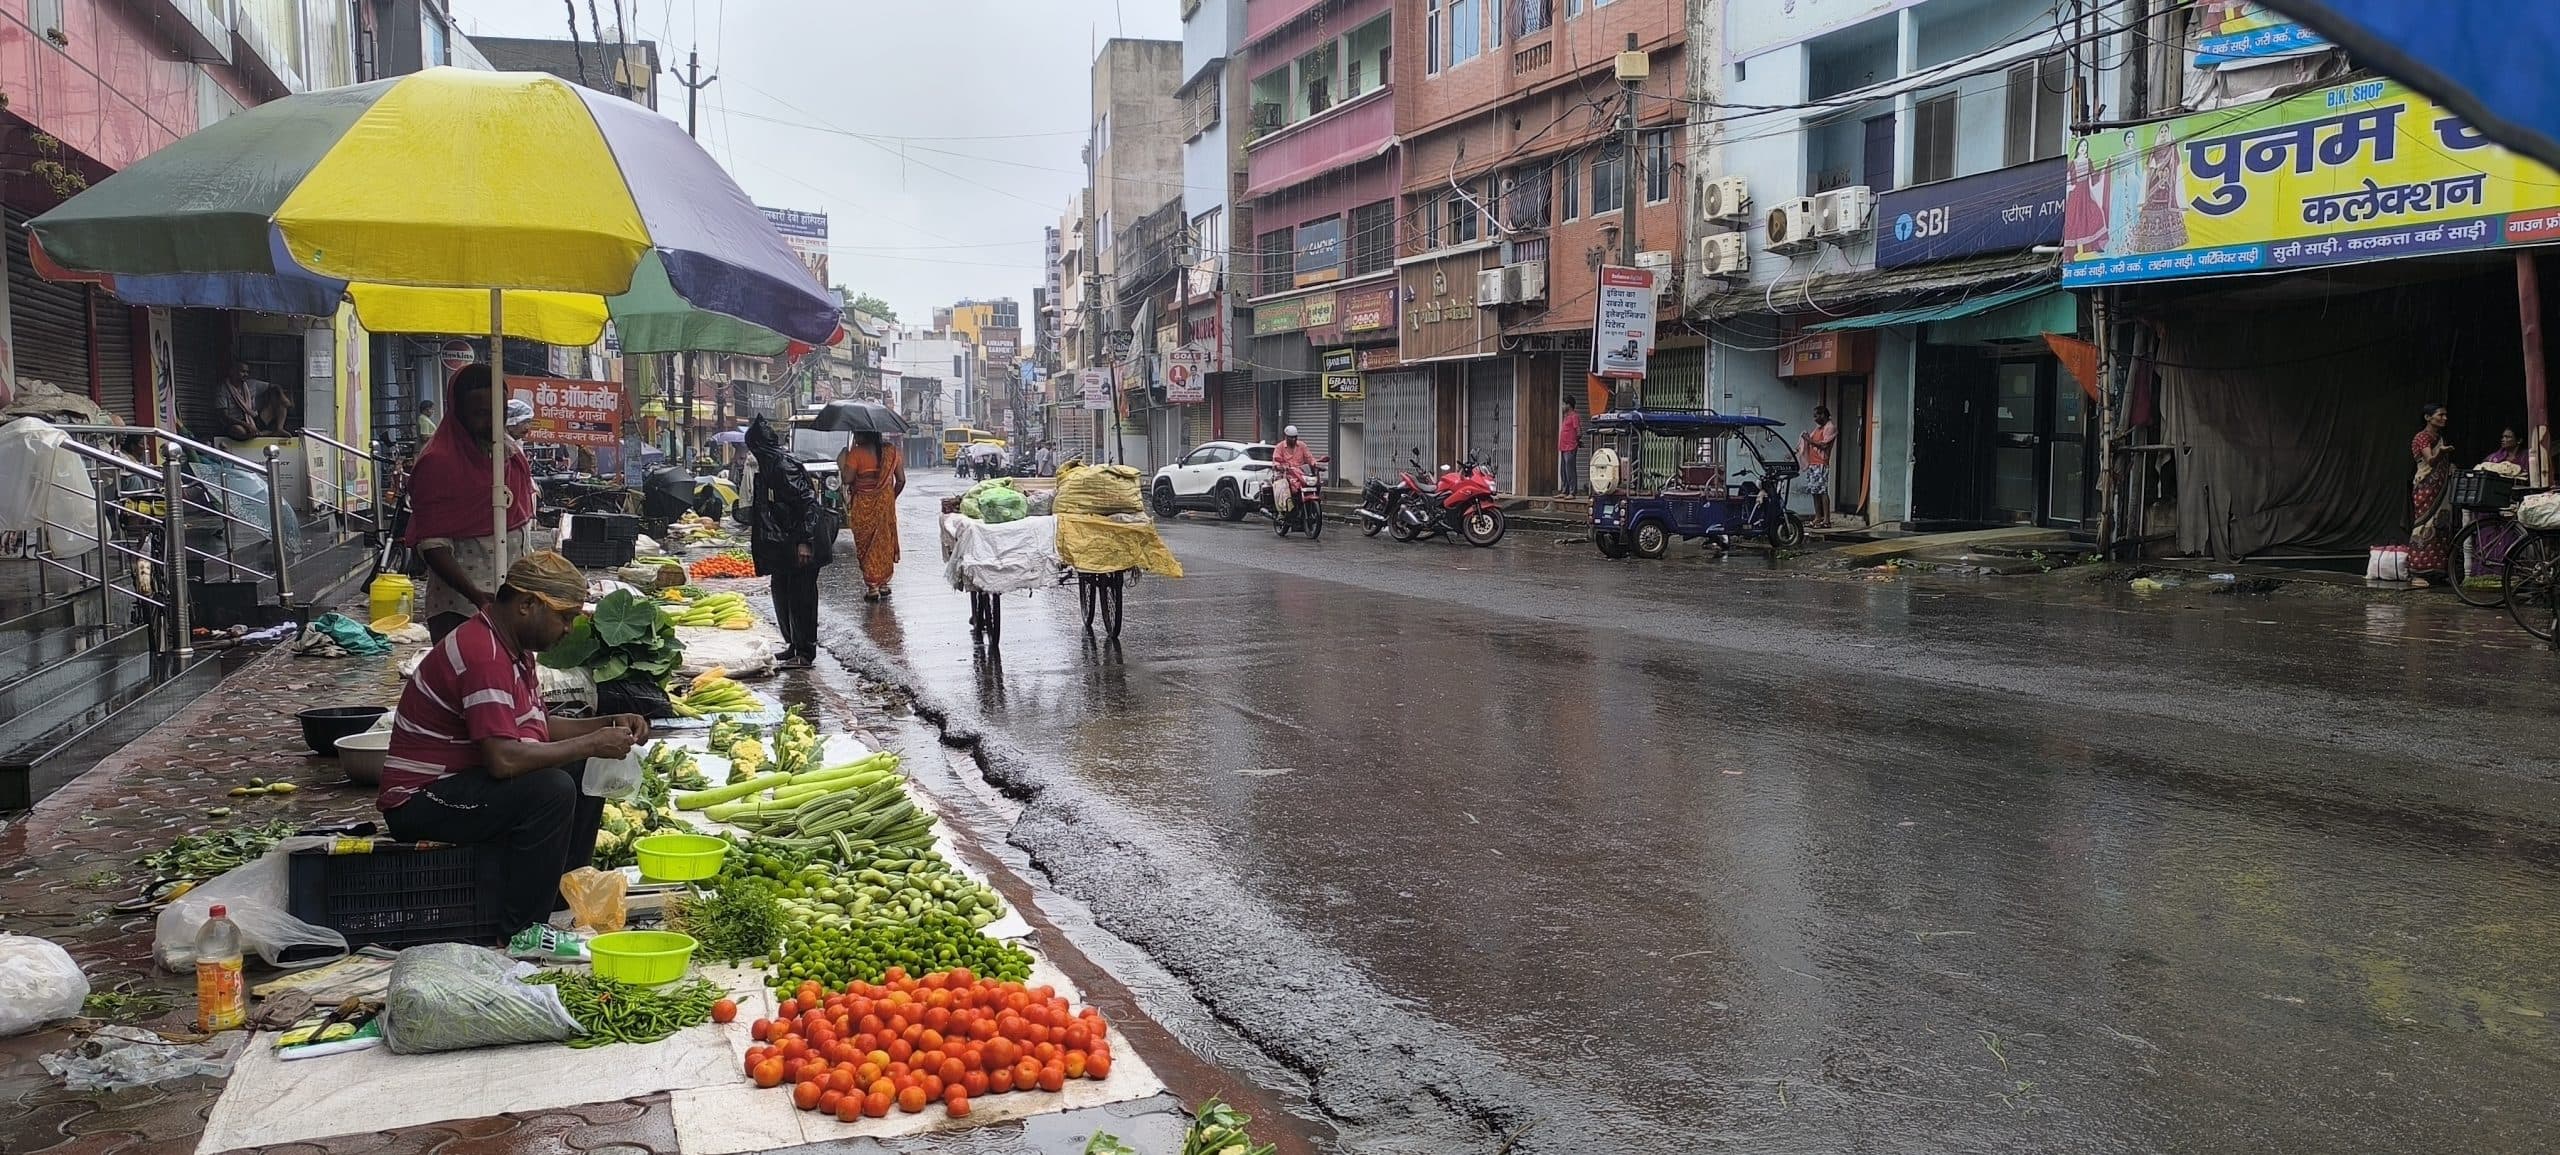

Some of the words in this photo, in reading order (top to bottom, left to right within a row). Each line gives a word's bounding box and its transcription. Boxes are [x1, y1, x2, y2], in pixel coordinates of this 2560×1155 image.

[2353, 82, 2385, 101] SHOP
[2185, 103, 2406, 217] पुनम
[2302, 172, 2488, 225] कलेक्शन
[1914, 206, 1950, 239] SBI
[2001, 202, 2033, 225] एटीएम
[2038, 199, 2065, 217] ATM
[2509, 219, 2543, 234] गाउन
[2273, 240, 2302, 264] सुती
[2346, 232, 2411, 251] कलकत्ता
[2414, 225, 2443, 243] वर्क
[2447, 219, 2488, 242] साड़ी
[2238, 246, 2259, 266] साड़ी
[536, 381, 558, 406] बैंक
[1328, 377, 1359, 385] GRAND
[578, 410, 607, 421] शाखा
